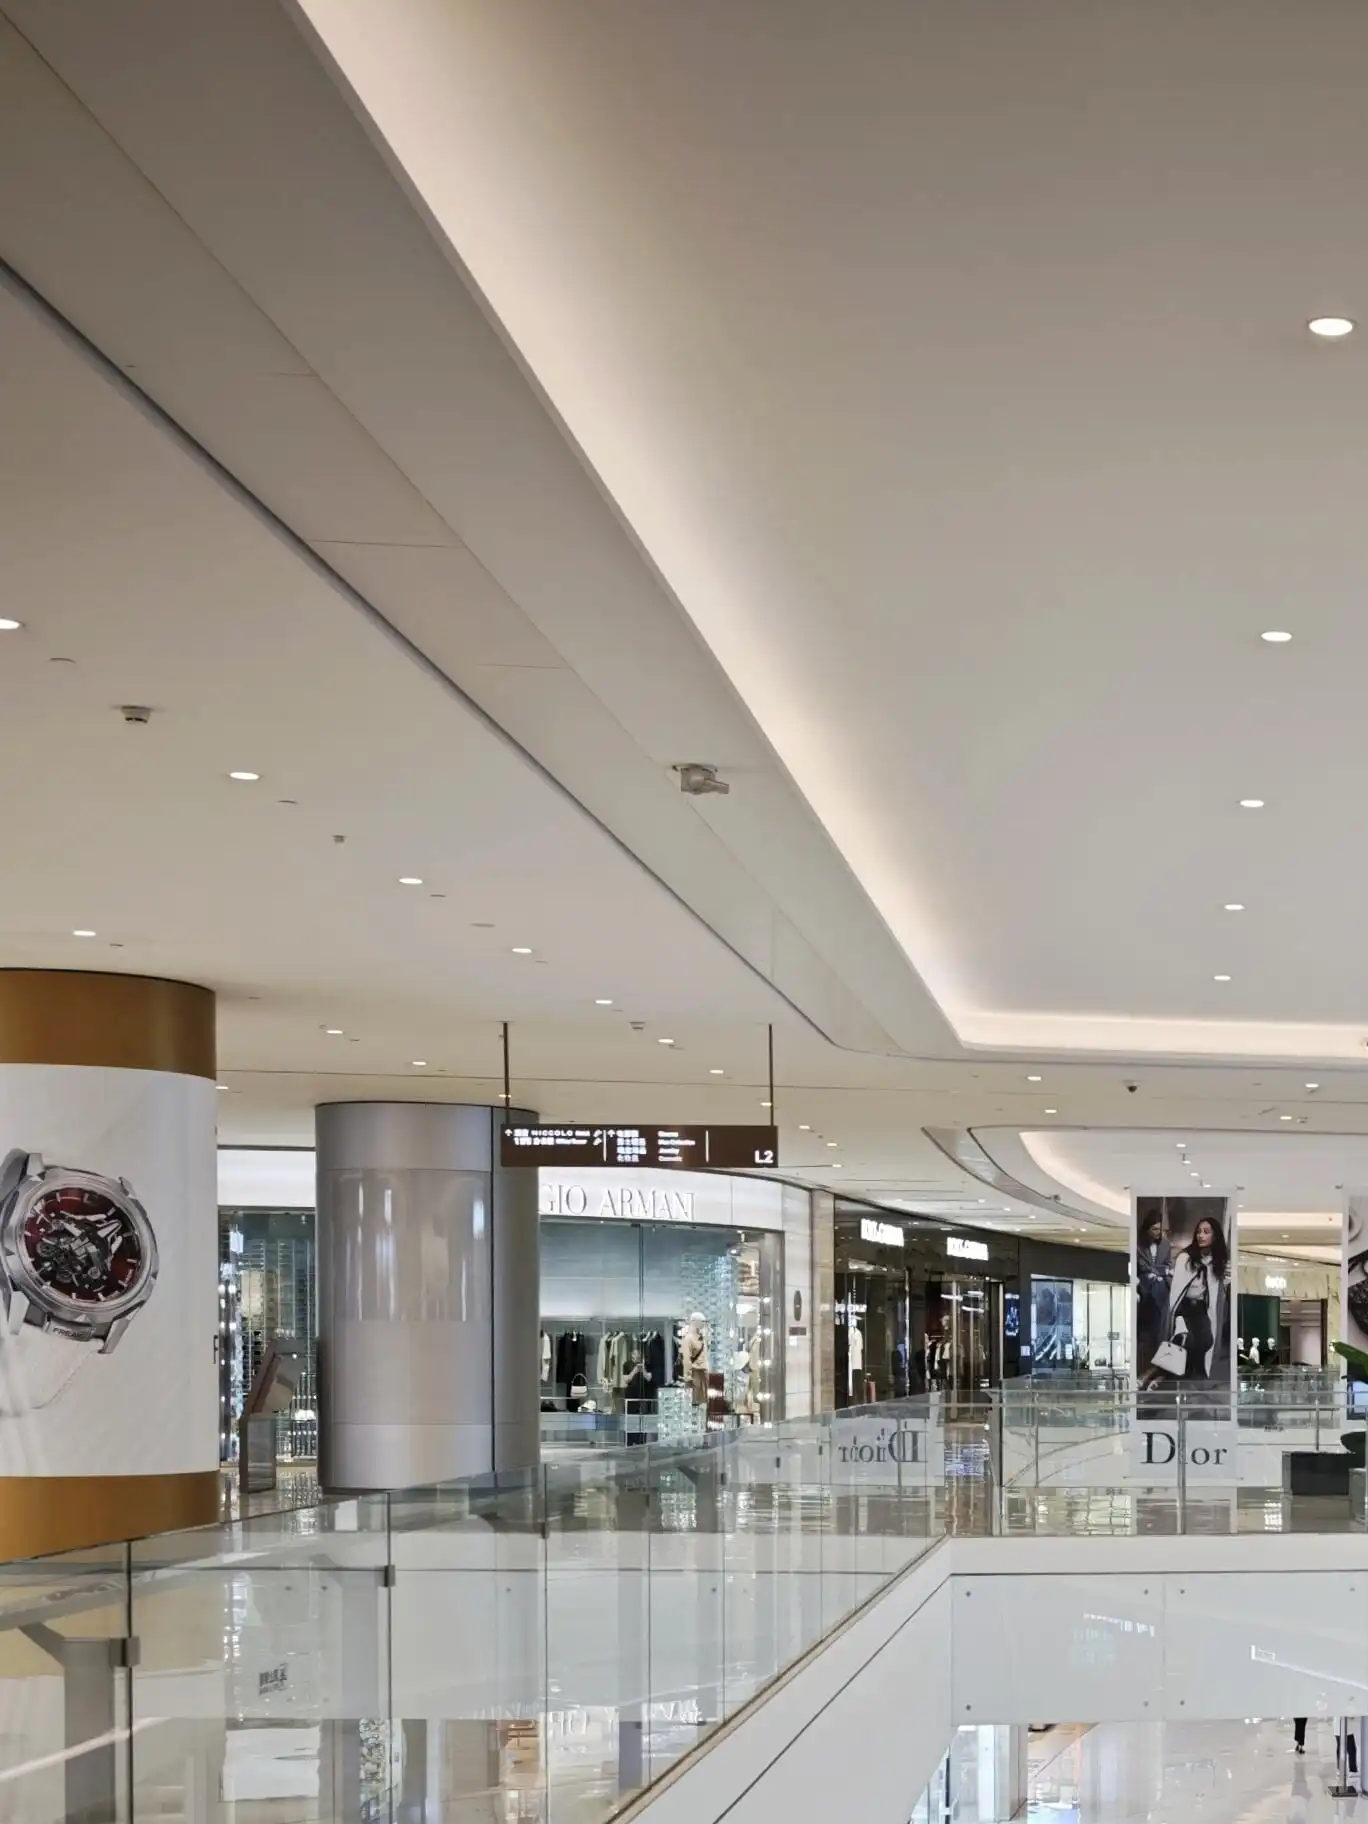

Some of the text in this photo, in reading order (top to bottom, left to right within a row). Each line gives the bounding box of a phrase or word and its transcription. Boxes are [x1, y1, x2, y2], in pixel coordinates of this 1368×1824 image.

[755, 1150, 774, 1164] L2
[600, 1188, 696, 1221] ARMANI
[1140, 1430, 1227, 1465] Dor
